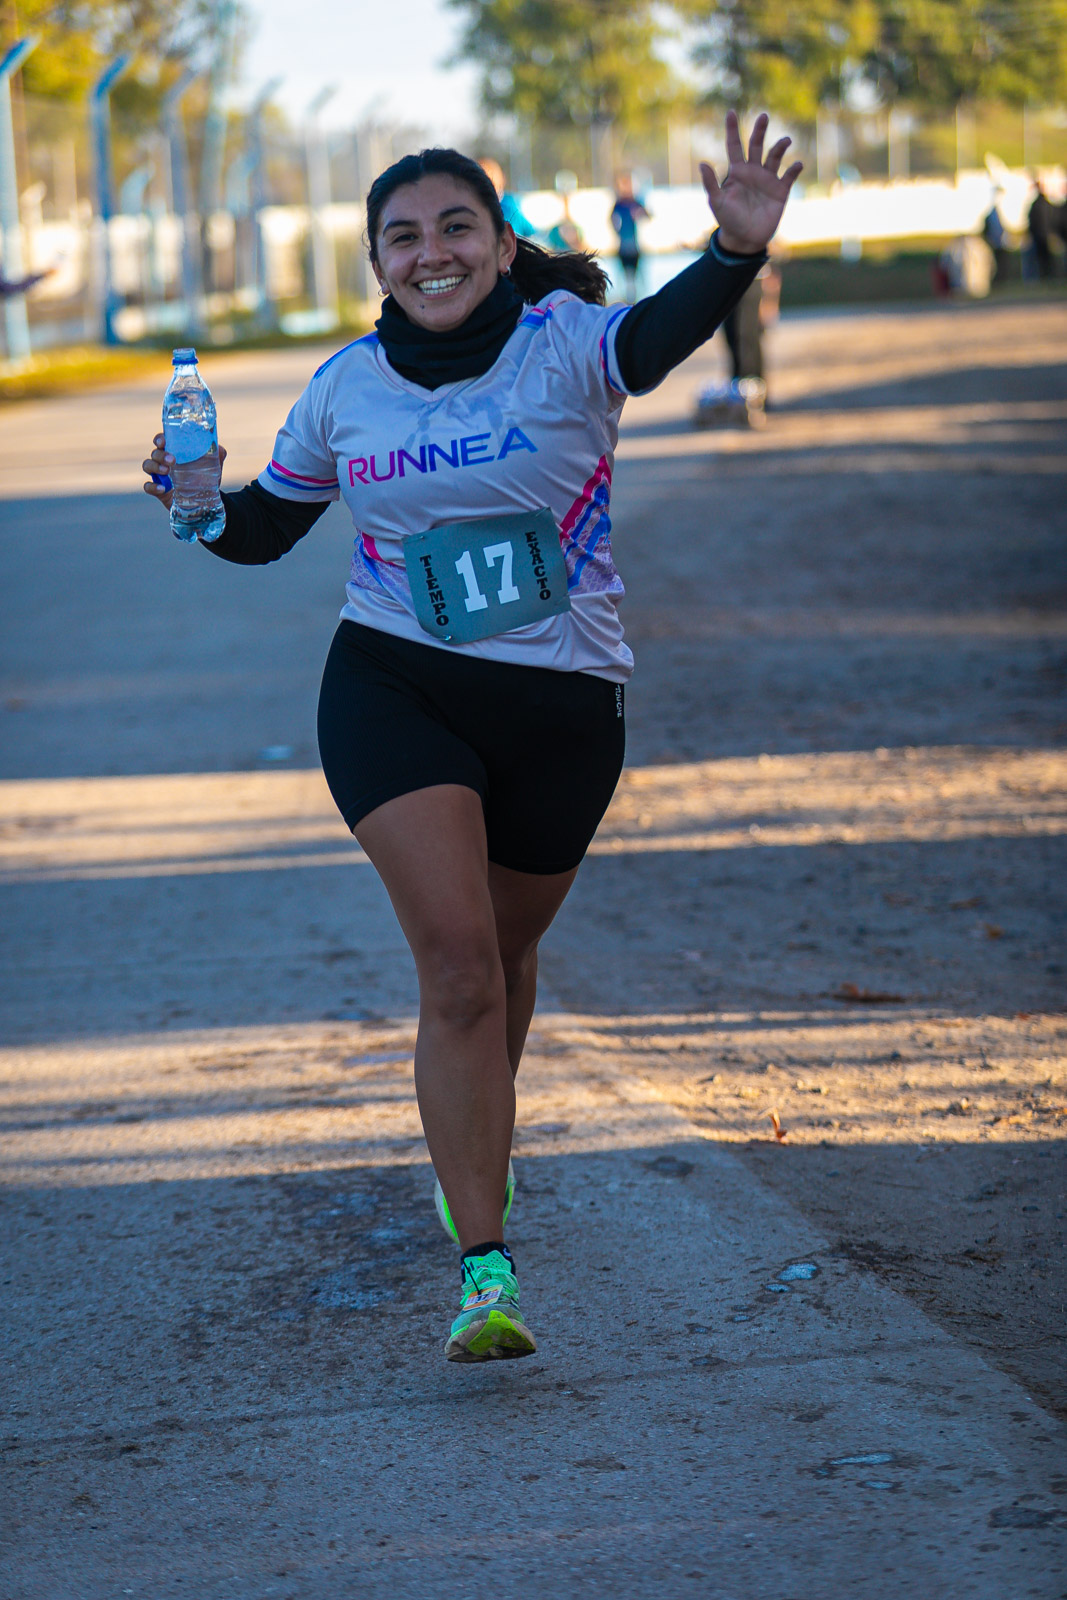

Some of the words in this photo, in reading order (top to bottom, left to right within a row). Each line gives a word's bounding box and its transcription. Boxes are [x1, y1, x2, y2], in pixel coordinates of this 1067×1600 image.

[348, 426, 538, 487] RUNNEA
[420, 554, 449, 626] TIEMPO
[454, 541, 520, 612] 17
[525, 531, 551, 600] EXACTO
